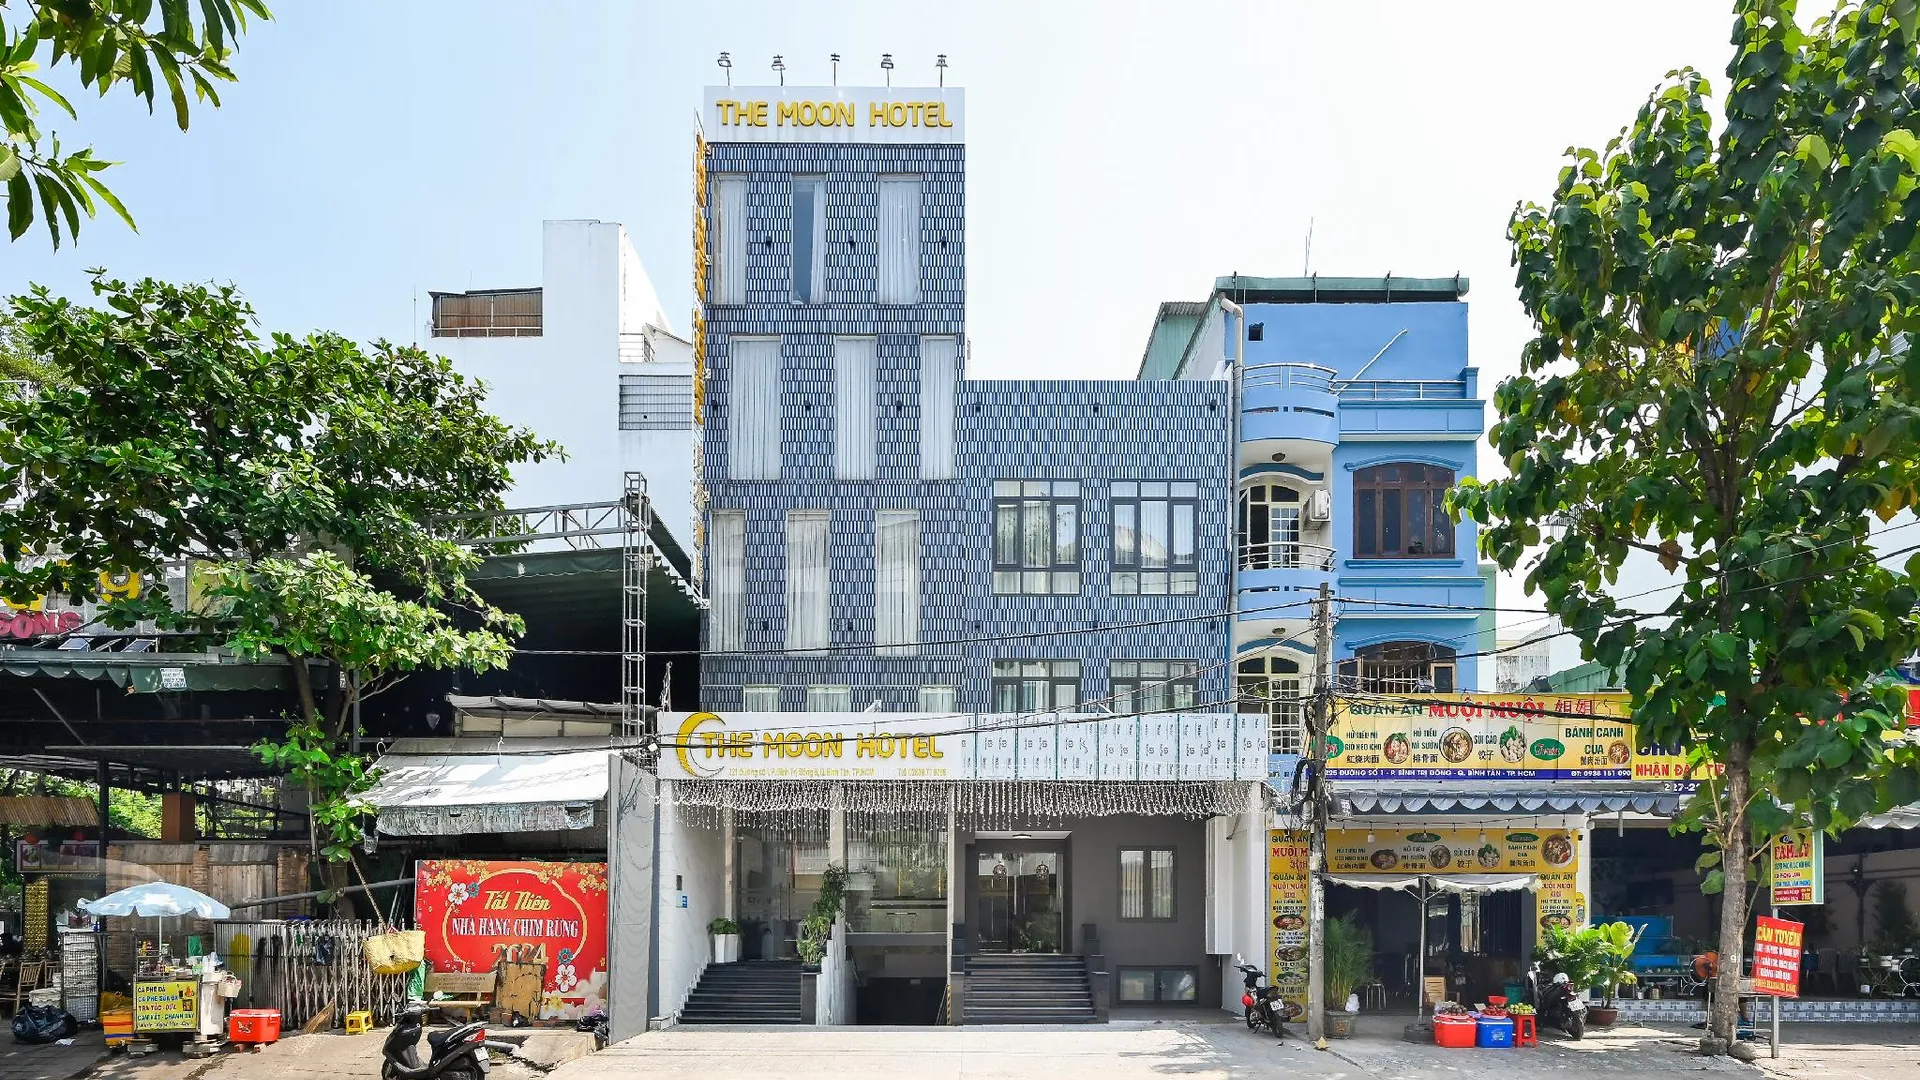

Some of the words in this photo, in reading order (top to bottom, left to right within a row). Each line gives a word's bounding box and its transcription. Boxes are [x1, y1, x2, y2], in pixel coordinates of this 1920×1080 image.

[716, 99, 768, 127] THE
[776, 100, 855, 127] MOON
[869, 101, 953, 128] HOTEL
[1428, 697, 1483, 722] MUỘI
[1490, 696, 1545, 723] MUỘI
[1566, 726, 1592, 738] BÁNH
[1596, 728, 1624, 738] CANH
[700, 732, 753, 758] THE
[762, 732, 842, 758] MOON
[856, 732, 944, 759] HOTEL
[1584, 744, 1603, 754] CUA
[1340, 768, 1366, 776] ĐƯỜNG
[1368, 768, 1378, 776] SỐ
[1398, 768, 1415, 776] BÌNH
[1468, 768, 1485, 776] BÌNH
[1636, 762, 1669, 778] NHẬN
[1272, 845, 1297, 860] MUỘI
[483, 890, 510, 910] Tất
[514, 890, 550, 911] Niên
[452, 916, 475, 936] NHÀ
[478, 916, 510, 936] HÀNG
[514, 918, 543, 937] CHIM
[546, 917, 578, 938] RỪNG
